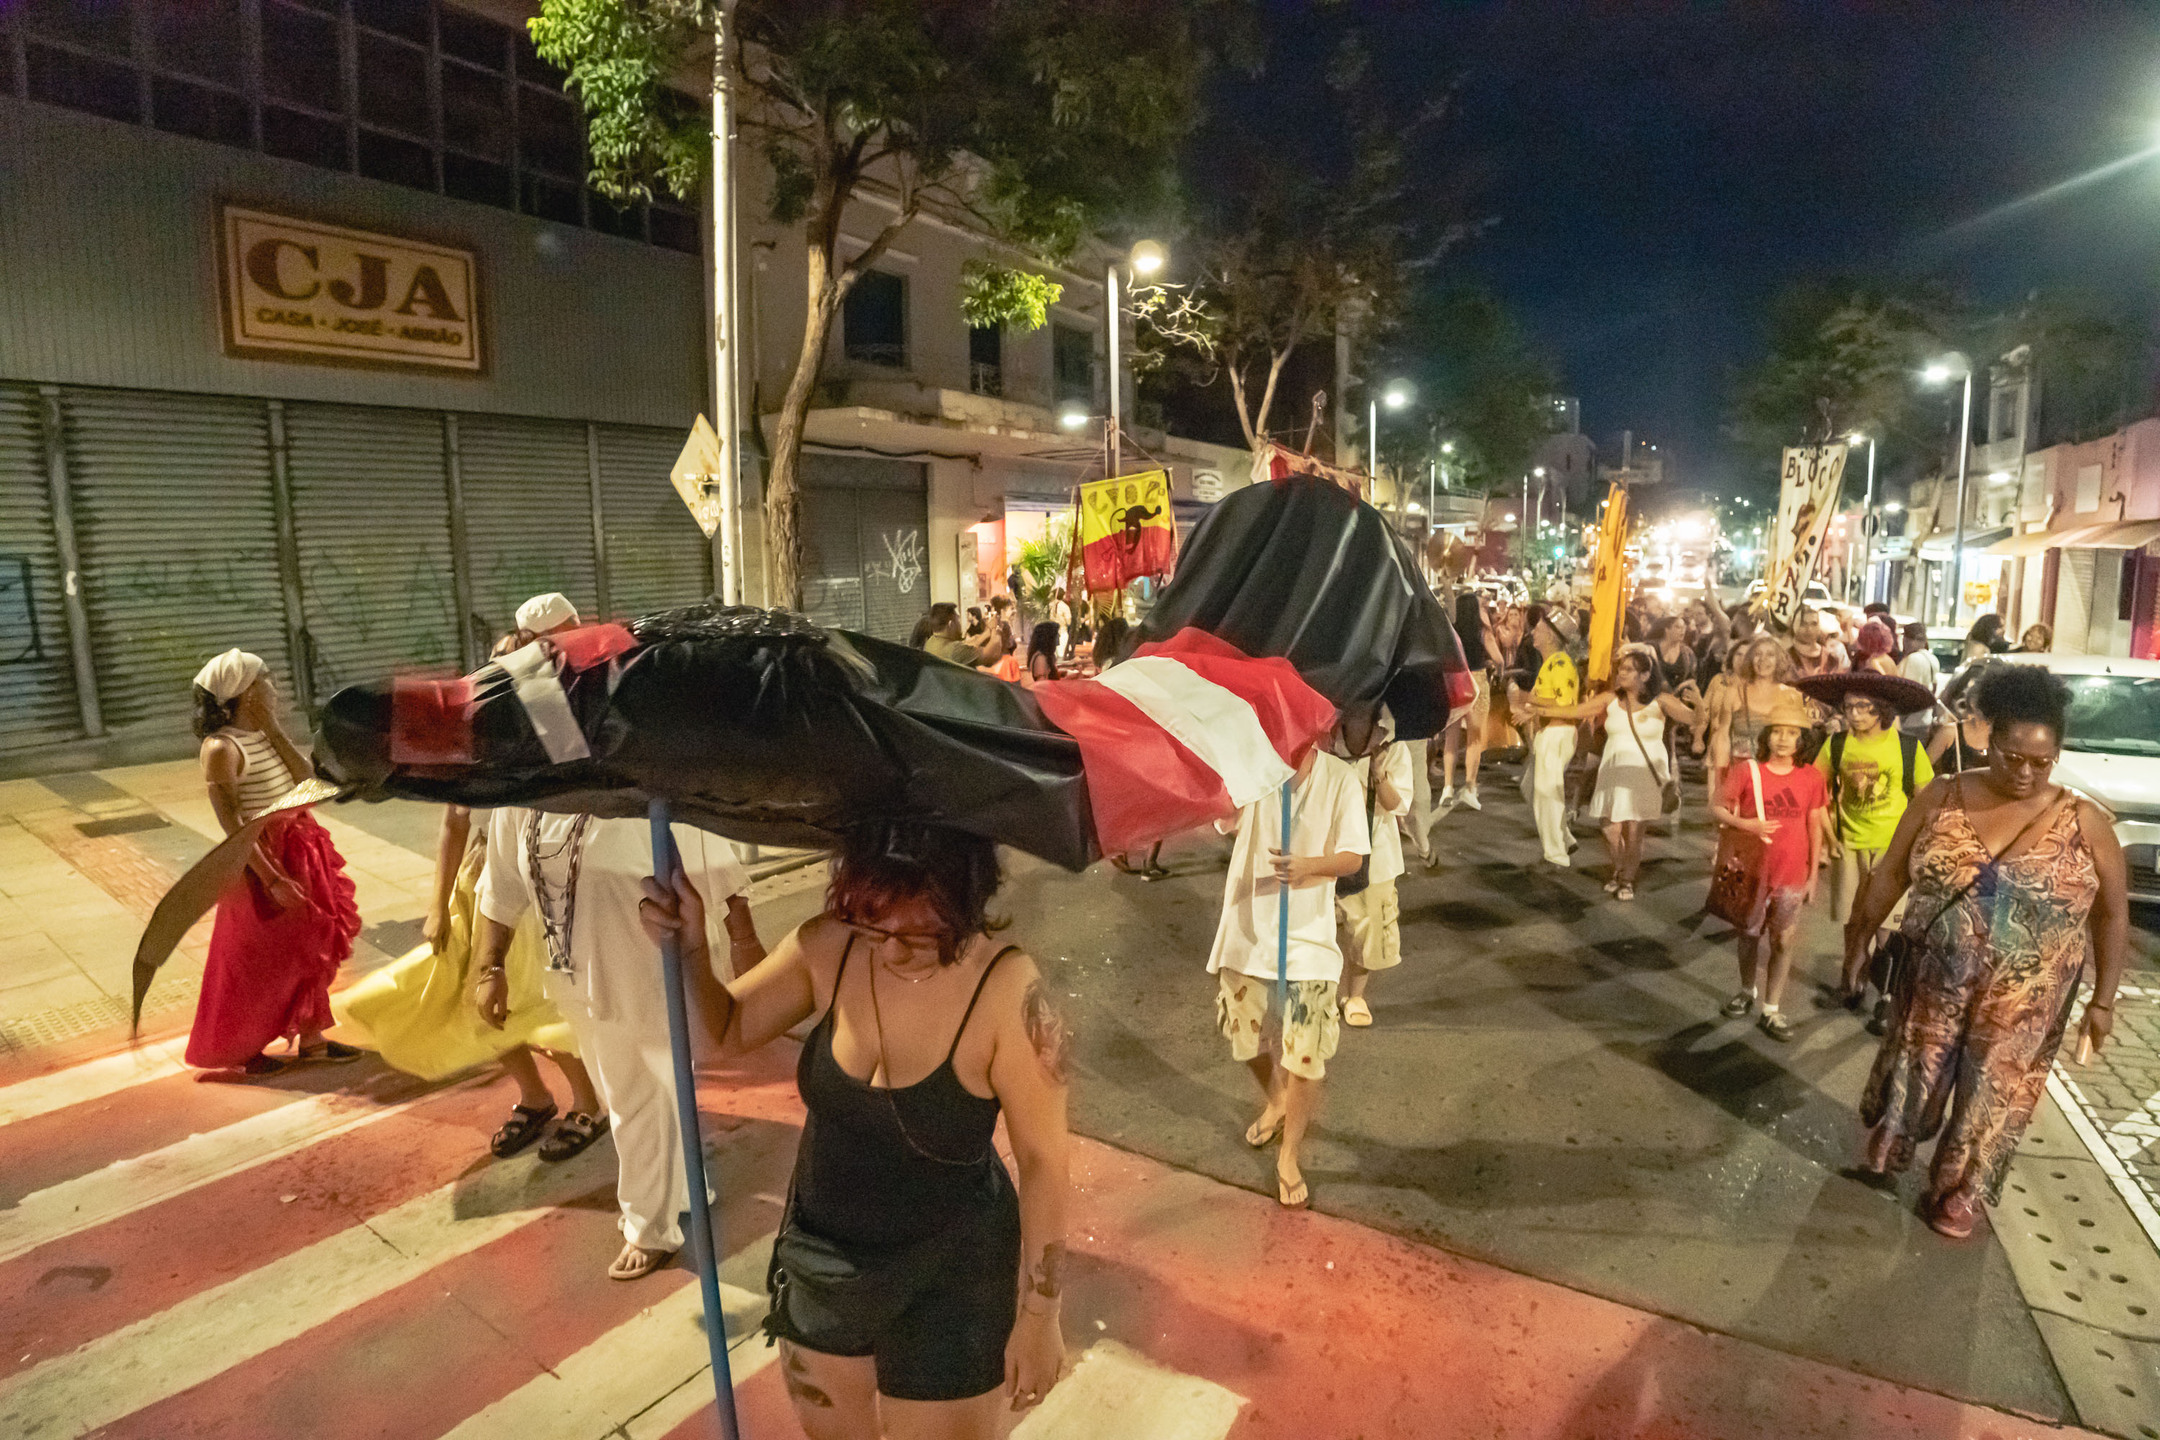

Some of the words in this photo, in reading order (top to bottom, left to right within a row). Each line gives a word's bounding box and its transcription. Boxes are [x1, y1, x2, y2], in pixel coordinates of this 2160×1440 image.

[246, 238, 465, 322] CJA
[255, 307, 315, 328] CASA
[1765, 806, 1802, 819] dida
